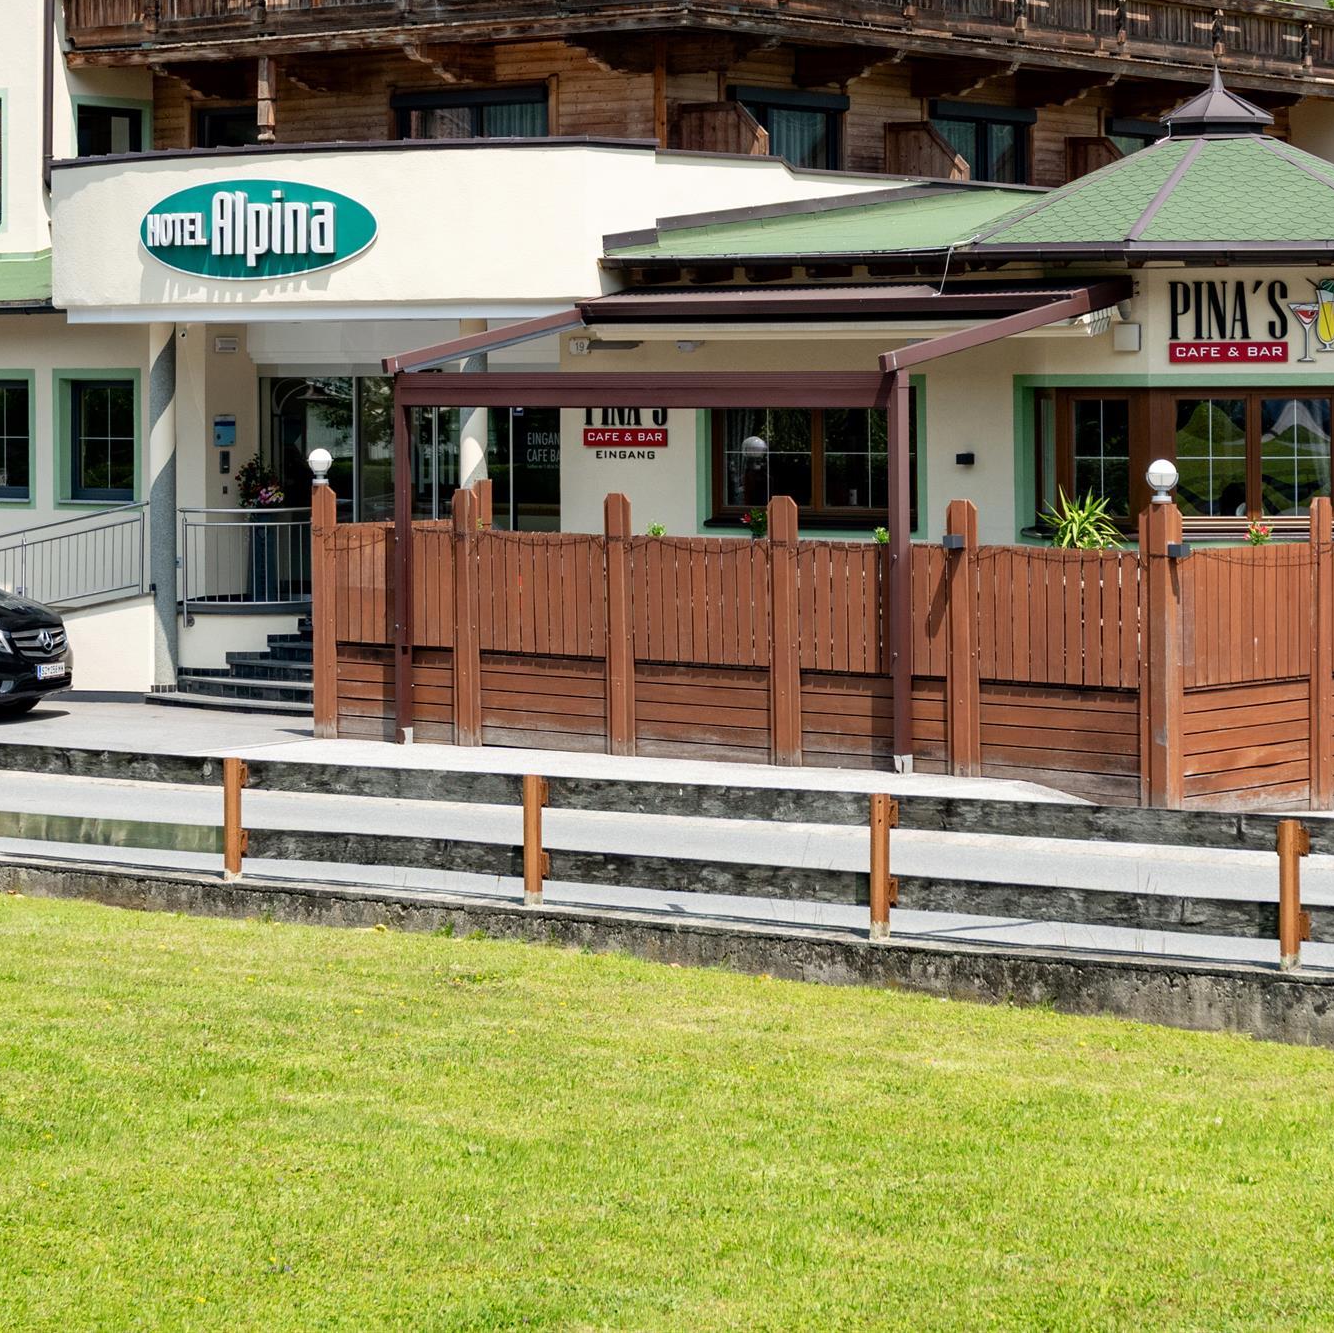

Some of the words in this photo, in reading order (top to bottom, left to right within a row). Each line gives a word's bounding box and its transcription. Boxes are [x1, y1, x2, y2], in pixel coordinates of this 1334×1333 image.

[146, 212, 209, 247] HOTEL
[211, 189, 337, 267] Alpina
[575, 342, 585, 351] 19
[1176, 347, 1220, 357] CAFE
[1228, 347, 1239, 356] &
[1247, 346, 1283, 356] BAR
[527, 431, 560, 446] EINGAN
[587, 432, 620, 442] CAFE
[624, 432, 633, 442] &
[638, 432, 663, 442] BAR
[526, 449, 548, 463] CAFE
[550, 449, 560, 463] BA
[596, 450, 656, 460] EINGANG
